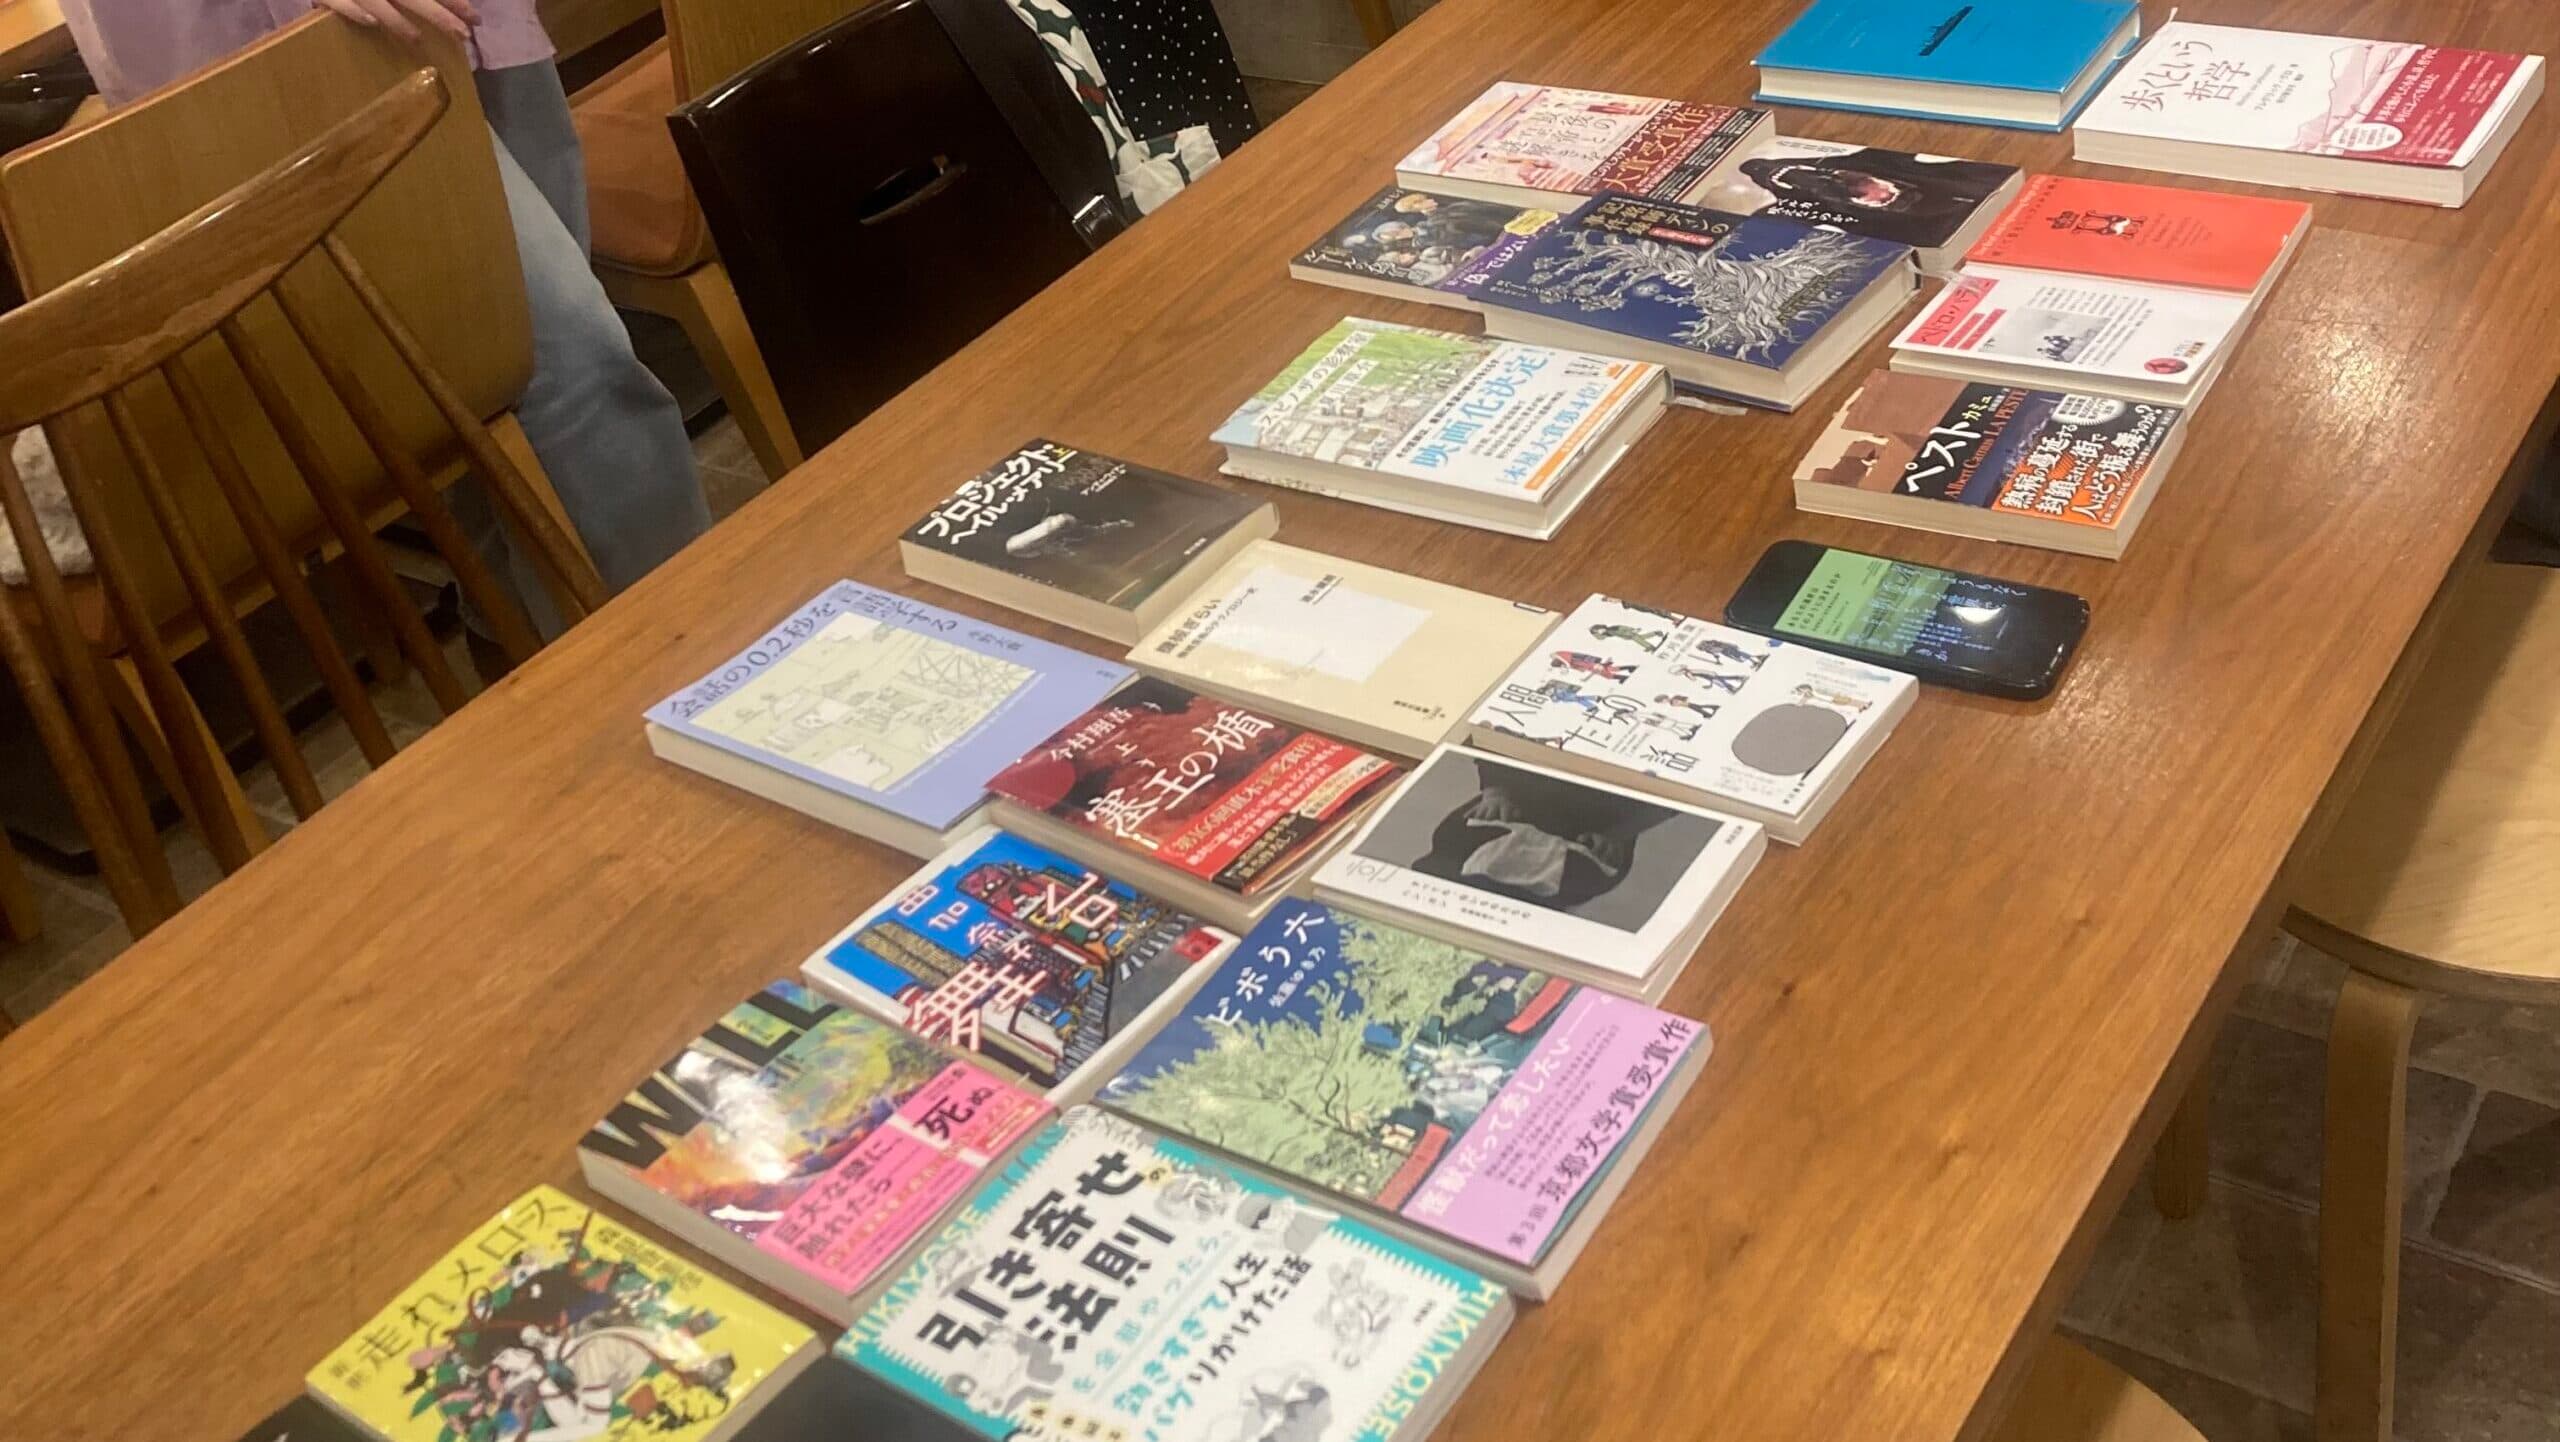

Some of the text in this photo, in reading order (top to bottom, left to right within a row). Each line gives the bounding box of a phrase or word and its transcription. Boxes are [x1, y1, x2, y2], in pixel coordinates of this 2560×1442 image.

[2112, 37, 2221, 113] 歩くという
[2181, 58, 2259, 103] 哲学
[1596, 105, 1715, 189] 大賞受賞作
[1051, 446, 1070, 456] 上
[1407, 346, 1556, 469] 映画化決定!
[1891, 416, 1989, 497] ペスト
[1959, 394, 1995, 420] カミュ
[1941, 388, 2031, 498] Albert Camus LA PESTE
[945, 447, 1081, 546] ヘイル・メアリー
[1999, 421, 2084, 509] 熱病の蔓延する
[2034, 431, 2113, 514] 封鎖された街で
[2069, 404, 2167, 519] 人はどう振る舞うのか?
[661, 600, 844, 719] 会話の0.2秒を
[1481, 682, 1554, 726] 人間
[1043, 705, 1138, 764] 今村翔吾
[1109, 740, 1140, 757] 上
[1560, 690, 1650, 750] たちの
[1637, 744, 1700, 773] 話
[1071, 705, 1281, 840] 塞王の楯
[1202, 908, 1328, 1027] ビボう六
[1530, 1015, 1696, 1205] 京都文学賞受賞作
[341, 1192, 570, 1369] 走れメロス
[1013, 1214, 1180, 1352] 法則
[1107, 1247, 1272, 1415] 効きすぎて人生
[1134, 1251, 1316, 1441] バグりかけた話
